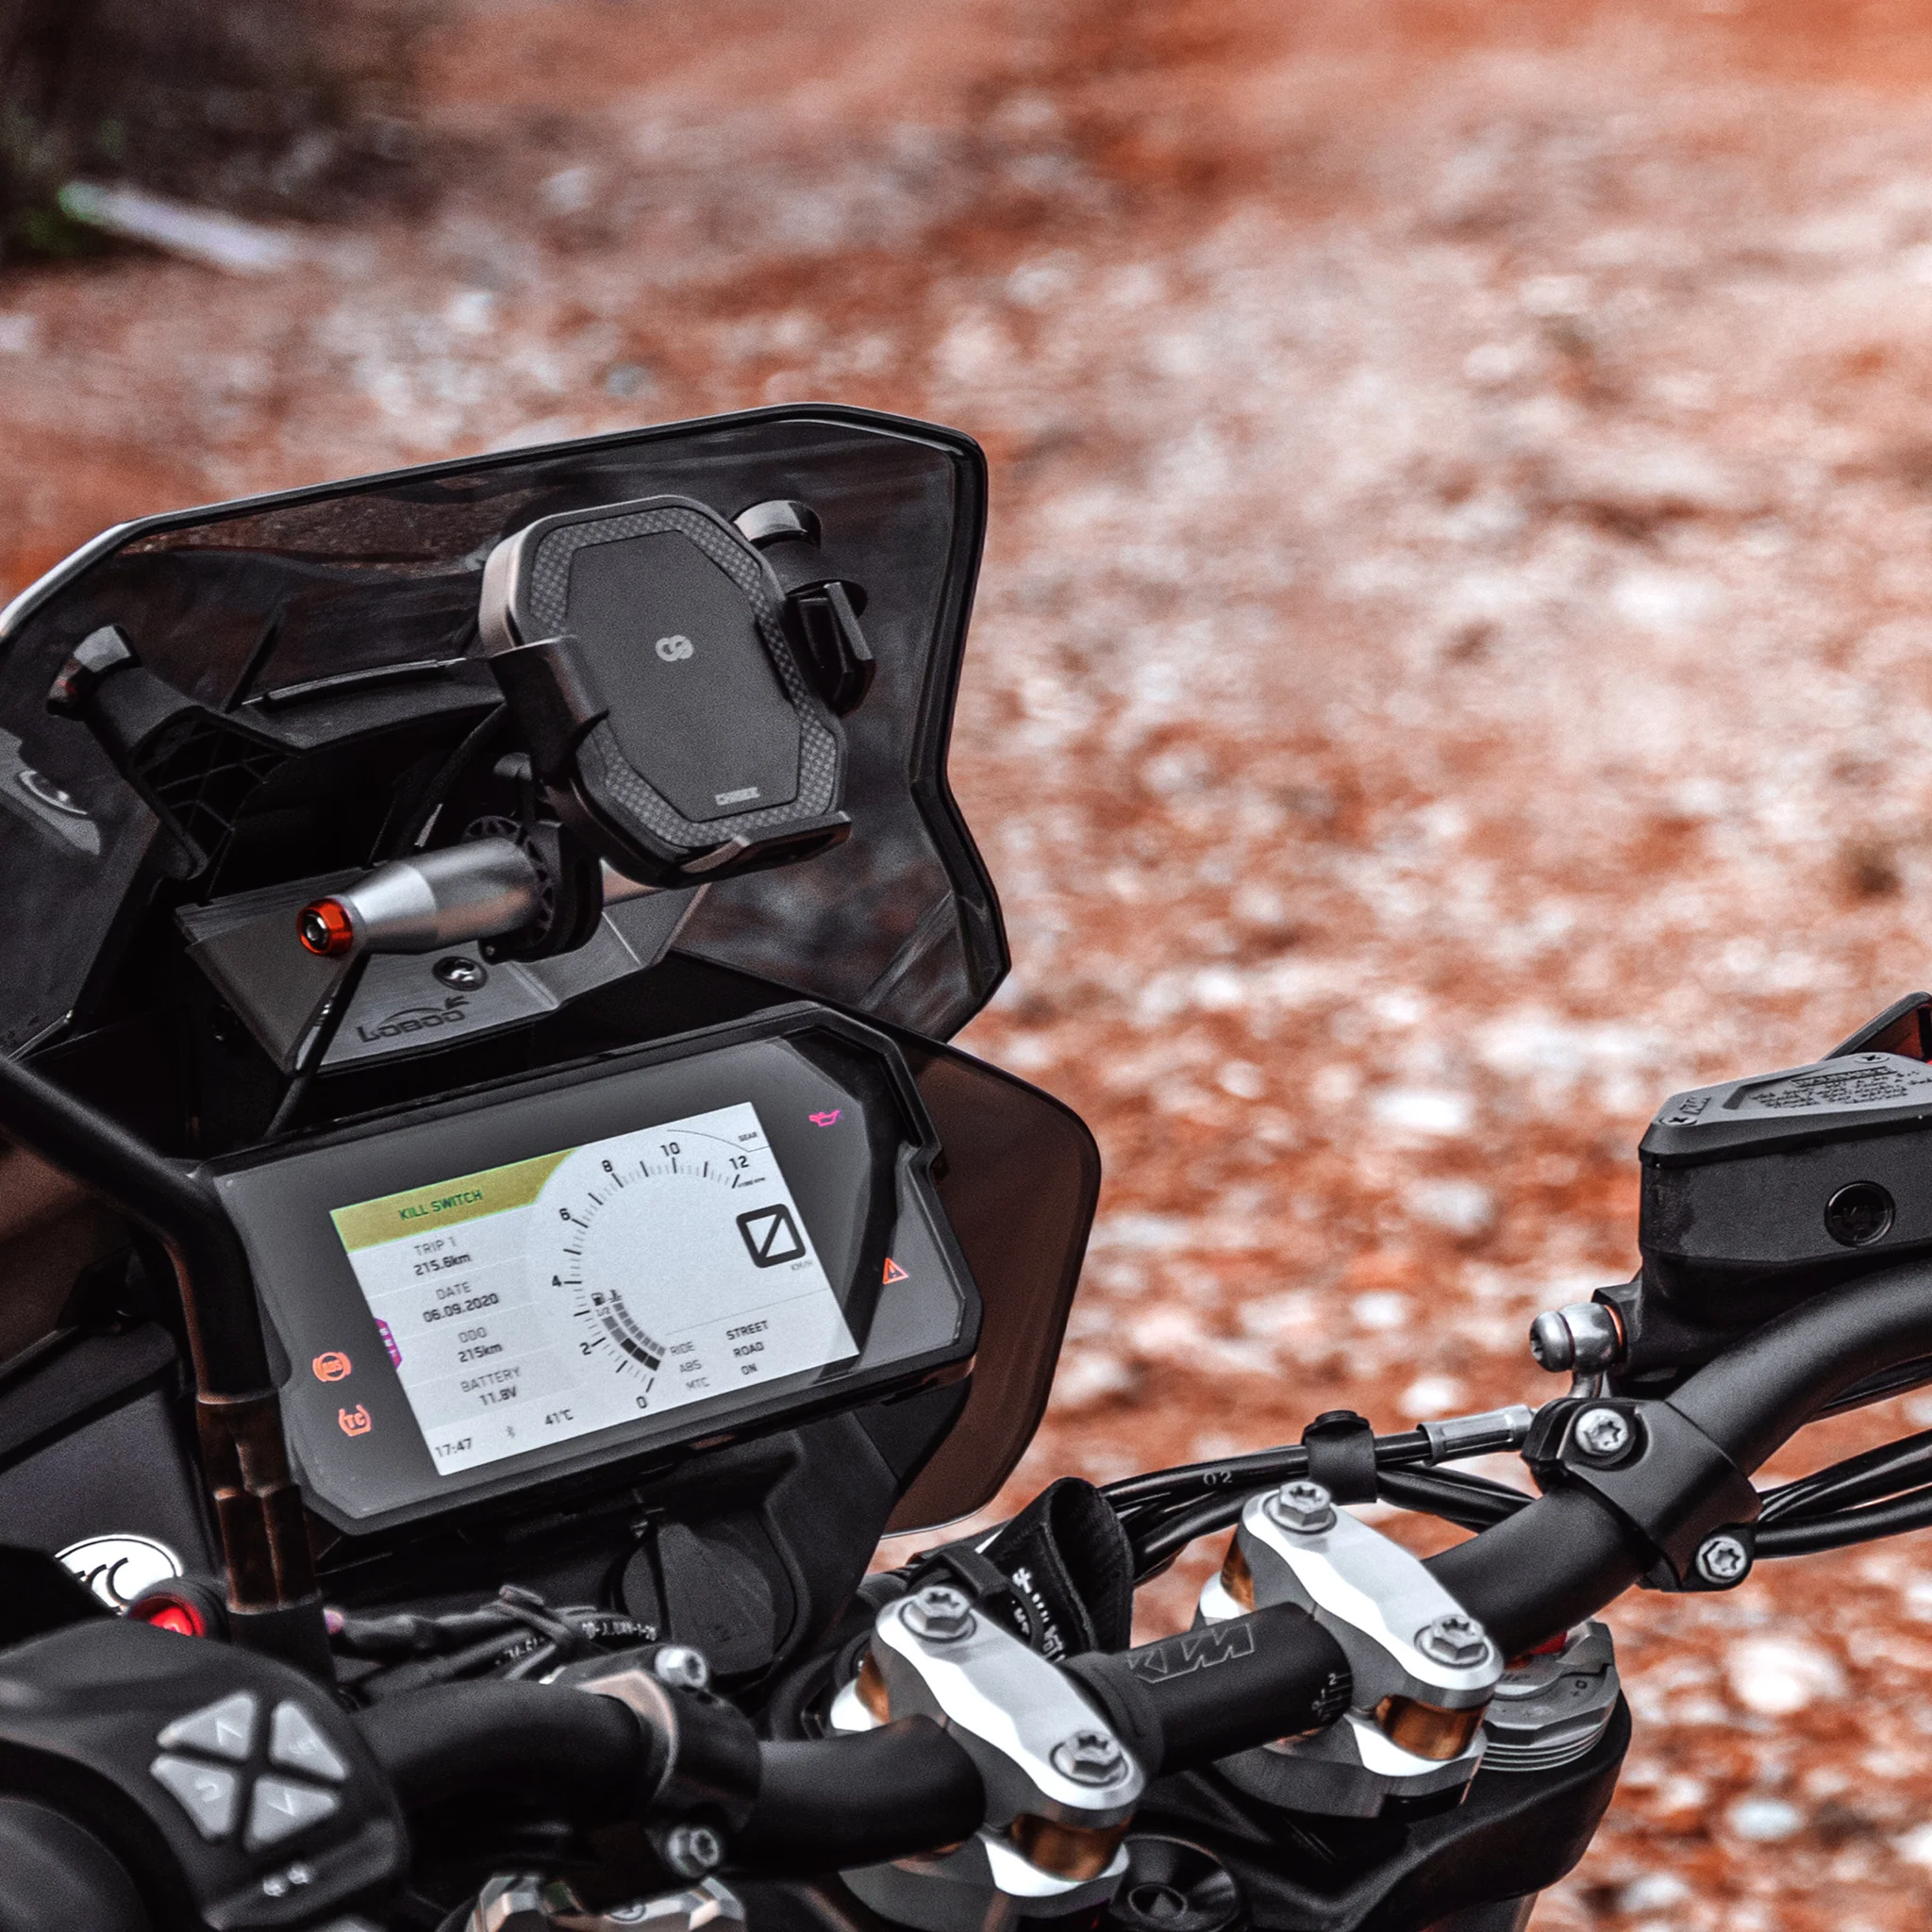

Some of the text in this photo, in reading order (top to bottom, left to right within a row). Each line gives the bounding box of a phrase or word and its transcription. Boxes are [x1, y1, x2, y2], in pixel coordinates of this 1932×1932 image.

[659, 1141, 681, 1157] 10
[601, 1159, 613, 1173] 8
[728, 1155, 750, 1170] 12
[398, 1189, 484, 1221] KILL SWITCH
[558, 1208, 572, 1222] 6
[413, 1235, 458, 1257] TRIP 1
[413, 1252, 472, 1276] 215.6km
[434, 1281, 472, 1300] DATE
[551, 1274, 563, 1288] 4
[422, 1293, 500, 1323] 06.09.2020
[578, 1341, 592, 1356] 2
[669, 1320, 770, 1357] RIDE STREET
[457, 1341, 503, 1363] 215km
[679, 1341, 765, 1374] ABS ROAD
[459, 1365, 521, 1393] BATTERY
[685, 1362, 758, 1390] MTC ON
[479, 1385, 518, 1407] 11.8V
[635, 1395, 649, 1409] 0
[434, 1437, 473, 1457] 17:47
